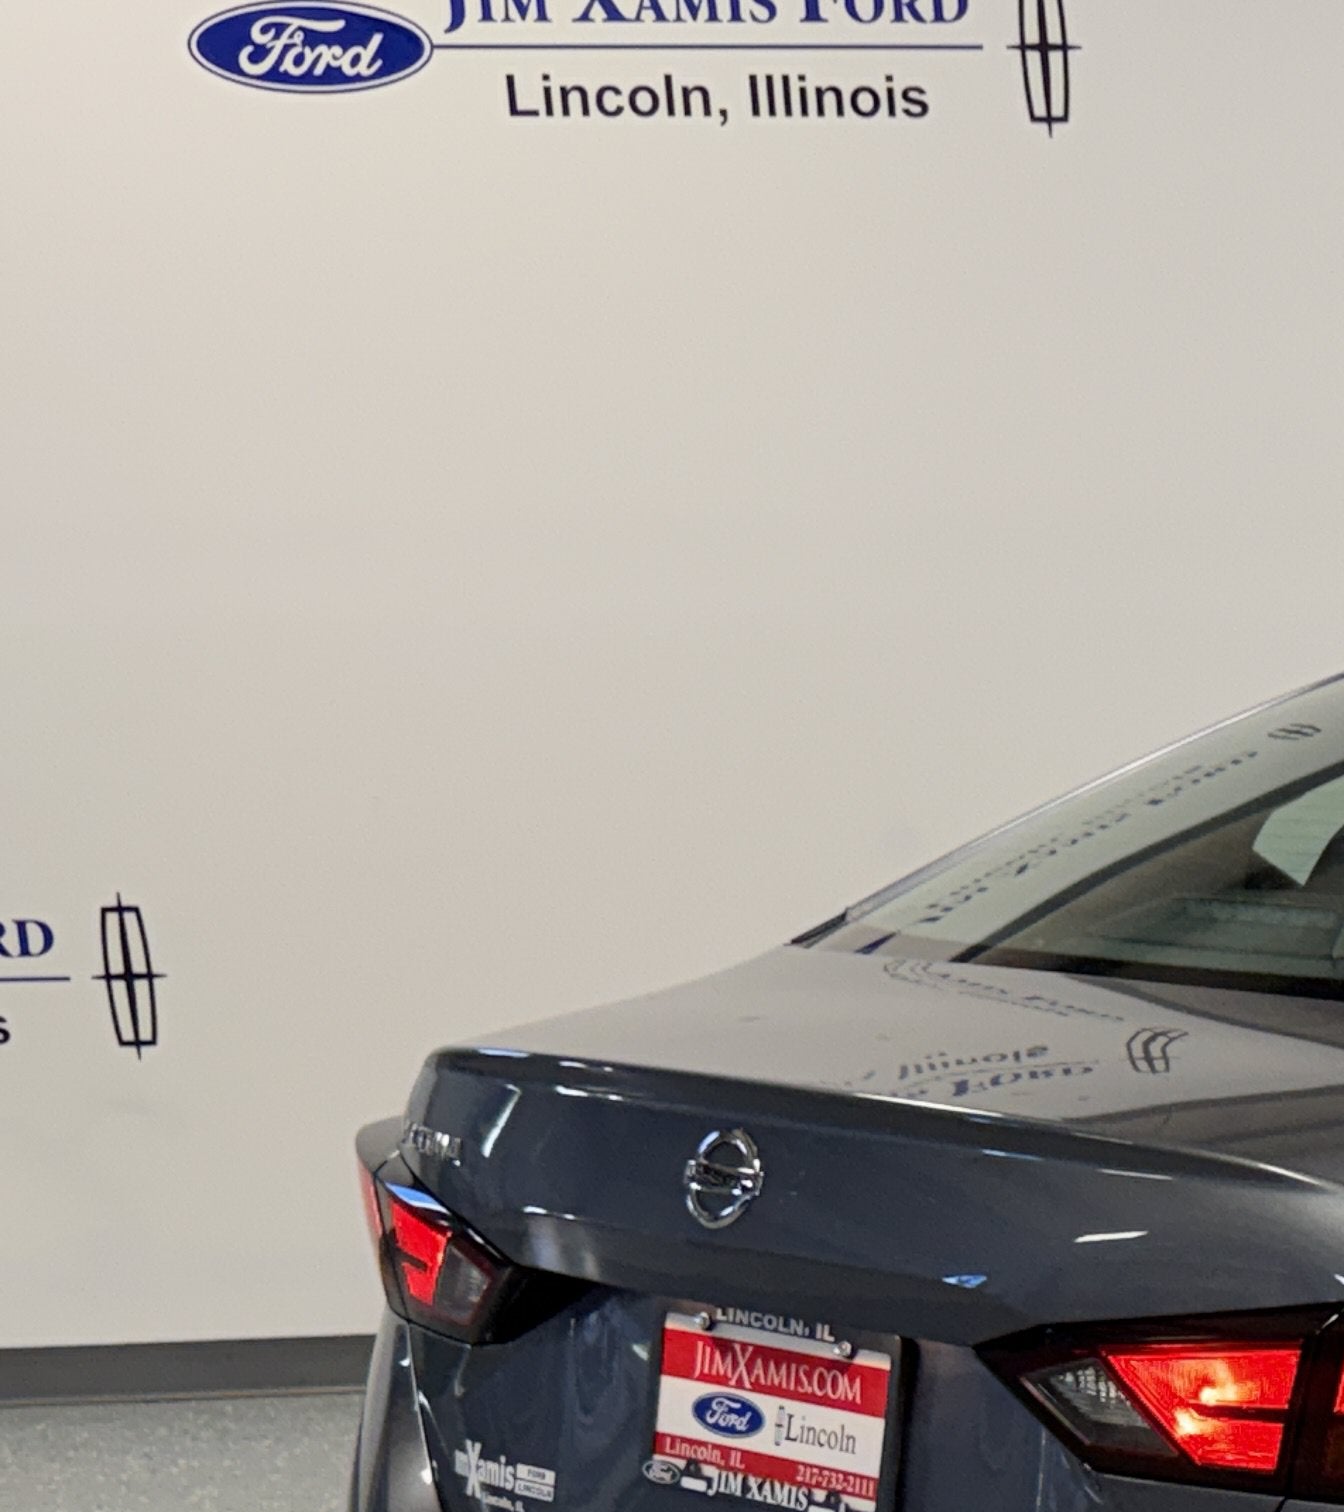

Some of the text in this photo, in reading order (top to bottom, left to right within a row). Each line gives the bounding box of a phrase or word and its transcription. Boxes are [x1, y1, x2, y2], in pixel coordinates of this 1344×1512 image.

[238, 15, 385, 77] Ford
[505, 73, 930, 127] Lincoln, Illinois
[815, 1323, 836, 1343] IL
[693, 1340, 862, 1405] JIMXAMIS.COM
[705, 1397, 751, 1432] Ford
[784, 1412, 857, 1455] Lincoln
[728, 1449, 746, 1470] IL
[706, 1468, 809, 1512] JIM XAMIS
